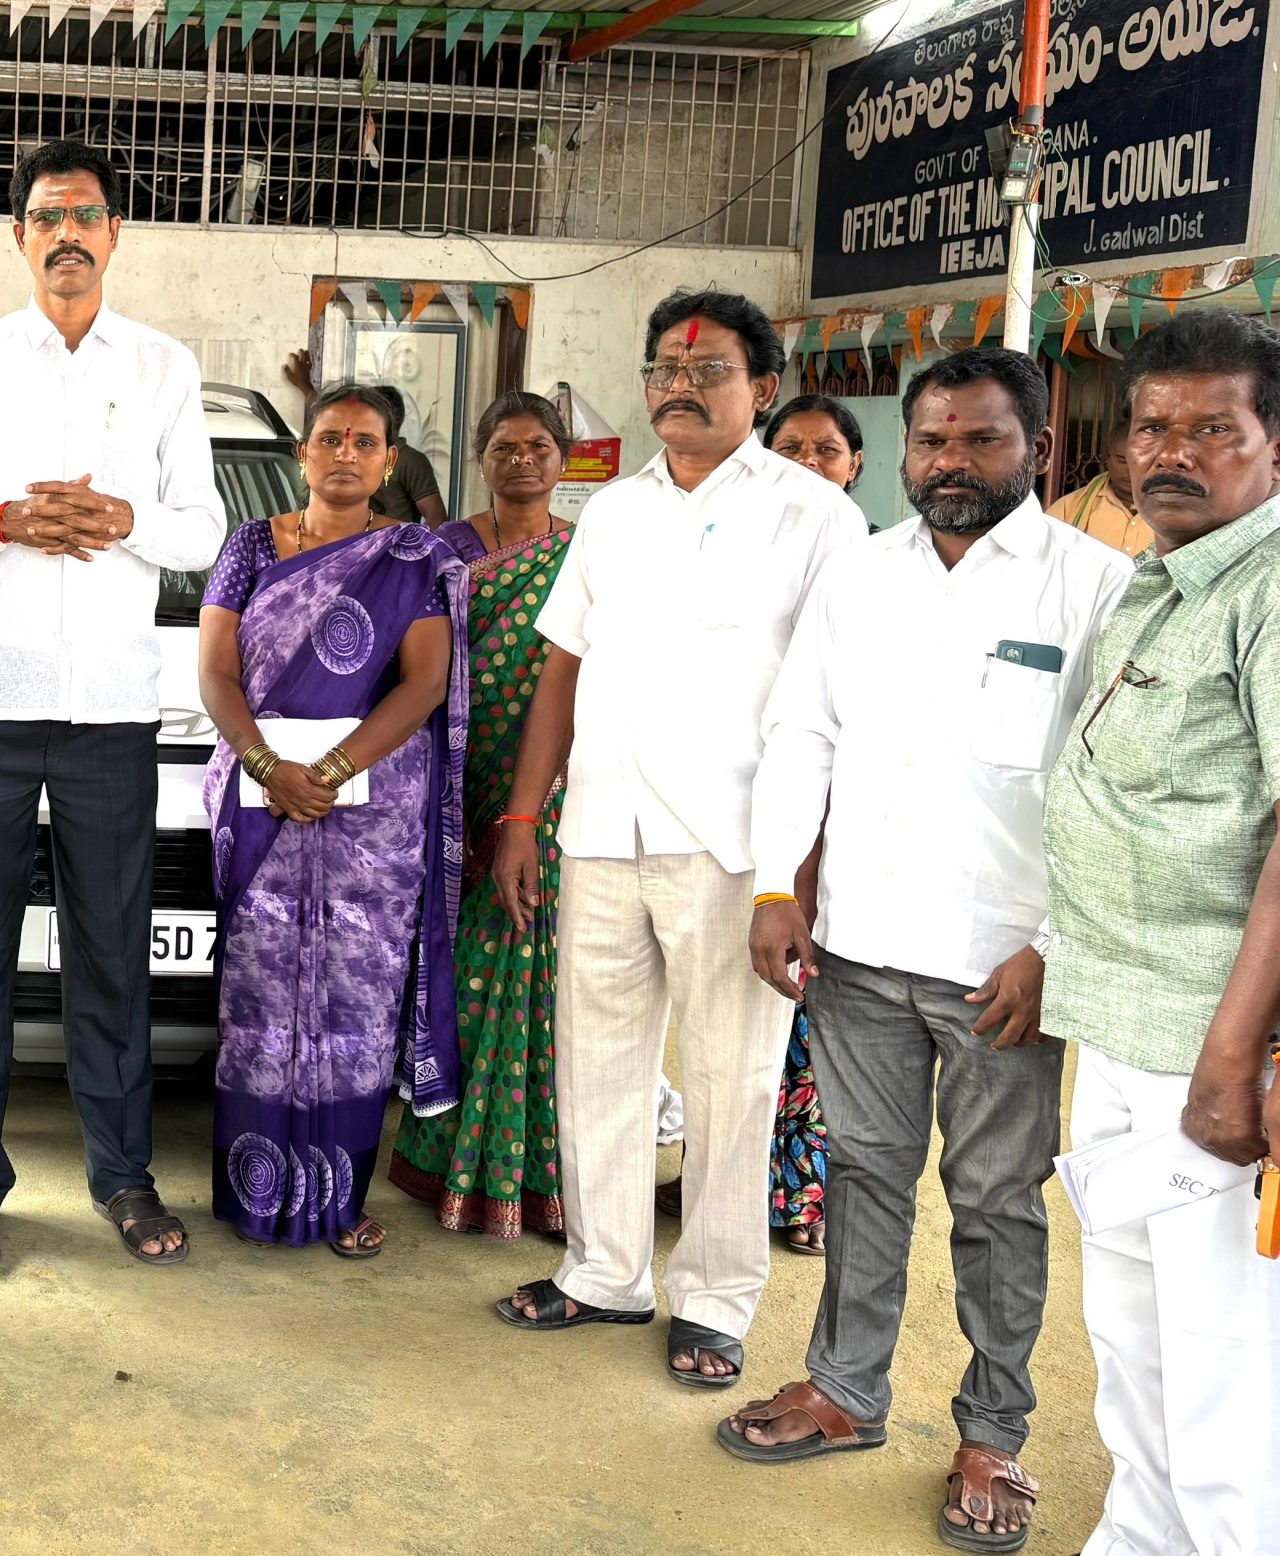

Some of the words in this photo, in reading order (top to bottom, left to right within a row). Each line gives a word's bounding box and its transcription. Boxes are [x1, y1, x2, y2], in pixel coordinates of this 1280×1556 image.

[845, 52, 977, 161] పురపాలక
[914, 152, 956, 185] GOVT
[961, 145, 984, 174] OF
[841, 196, 908, 254] OFFICE
[909, 189, 936, 243] OF
[937, 180, 975, 238] THE
[975, 155, 1097, 232] MUIPAL
[1168, 210, 1204, 243] Dist
[939, 234, 1006, 275] IEEJA
[1168, 1173, 1204, 1195] SEC
